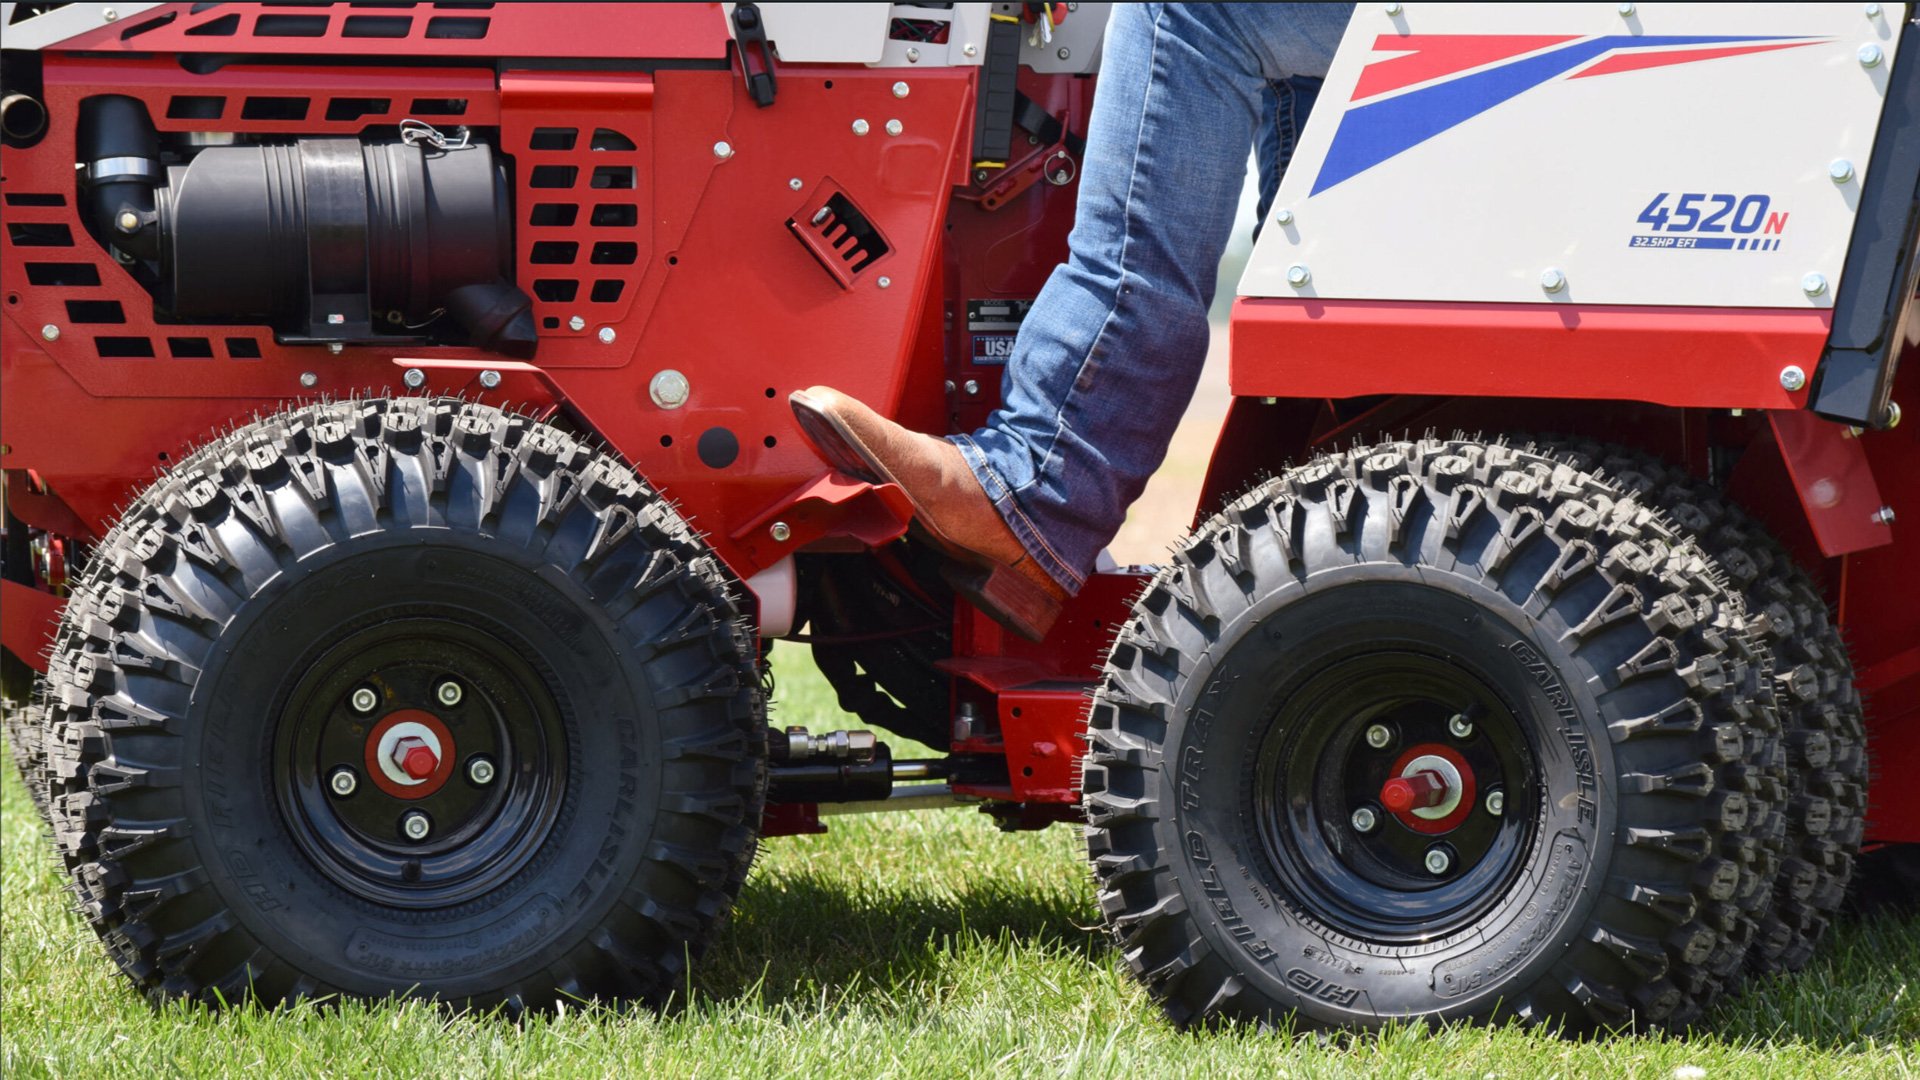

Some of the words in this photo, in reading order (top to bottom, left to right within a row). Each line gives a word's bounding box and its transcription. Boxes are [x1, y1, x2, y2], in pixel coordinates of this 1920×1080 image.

[1633, 237, 1674, 247] 32.5HP
[1676, 238, 1698, 248] EFI
[985, 340, 1015, 356] USA
[1180, 664, 1238, 811] TRAX
[1508, 639, 1596, 826] CARLISLE
[569, 717, 638, 909] CARLISLE
[225, 850, 283, 913] HD
[1185, 829, 1279, 963] FIELD
[1286, 967, 1361, 1009] HD
